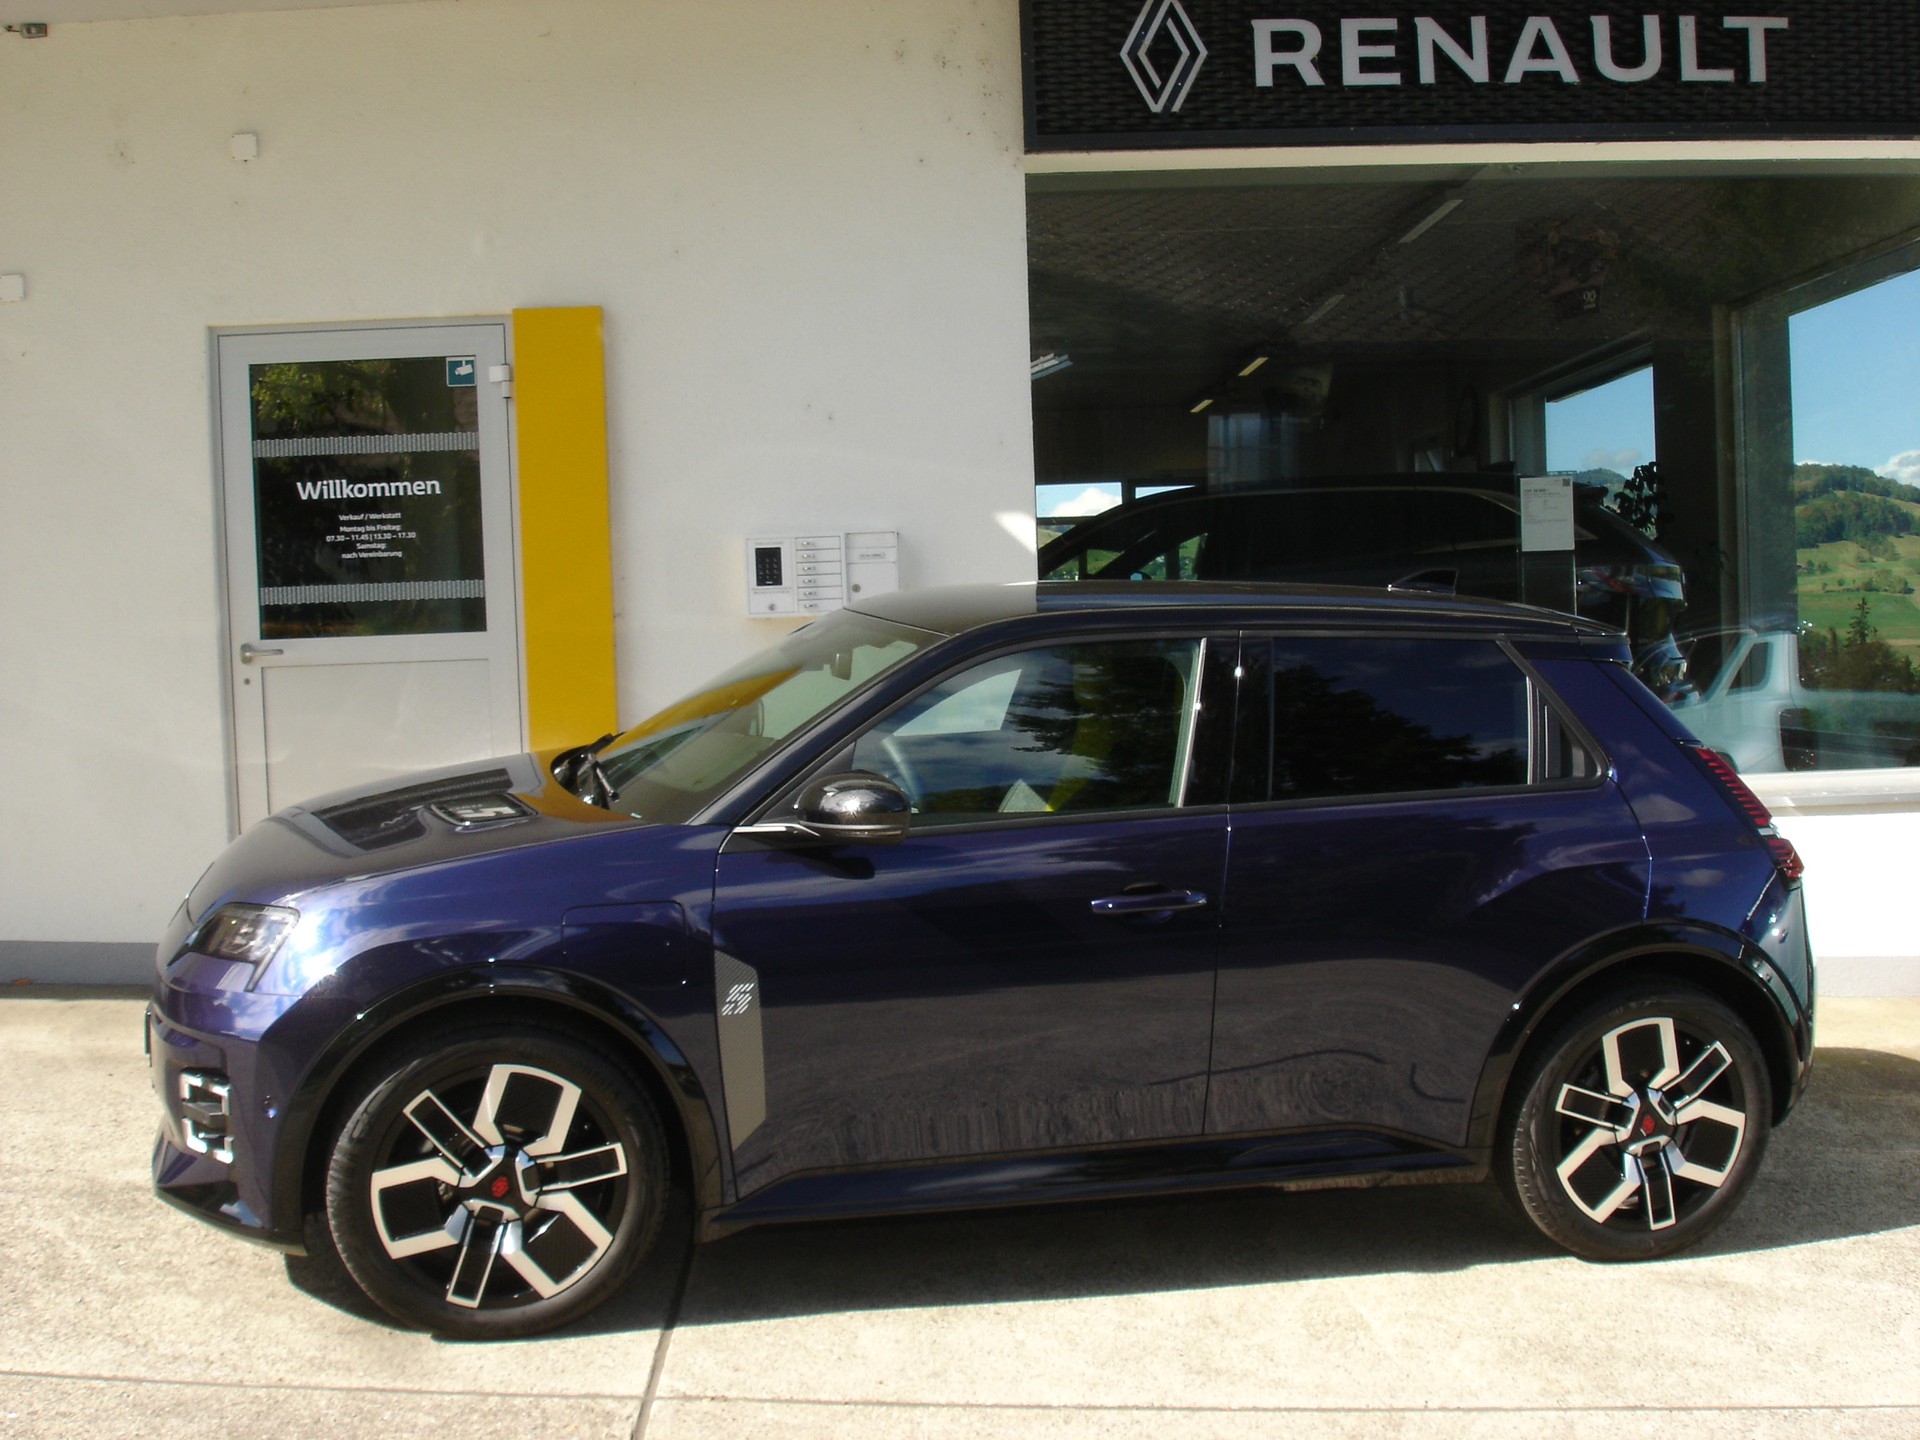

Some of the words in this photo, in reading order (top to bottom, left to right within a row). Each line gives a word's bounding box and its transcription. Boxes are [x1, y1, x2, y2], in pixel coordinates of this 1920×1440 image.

[1251, 14, 1788, 88] RENAULT
[296, 479, 441, 500] Willkommen
[338, 513, 364, 521] Verkauf
[369, 512, 402, 520] Werkstatt
[339, 525, 365, 533] Montag
[376, 524, 401, 532] Freitag:
[356, 542, 386, 550] Samstag:
[358, 551, 403, 559] Vereinbarung
